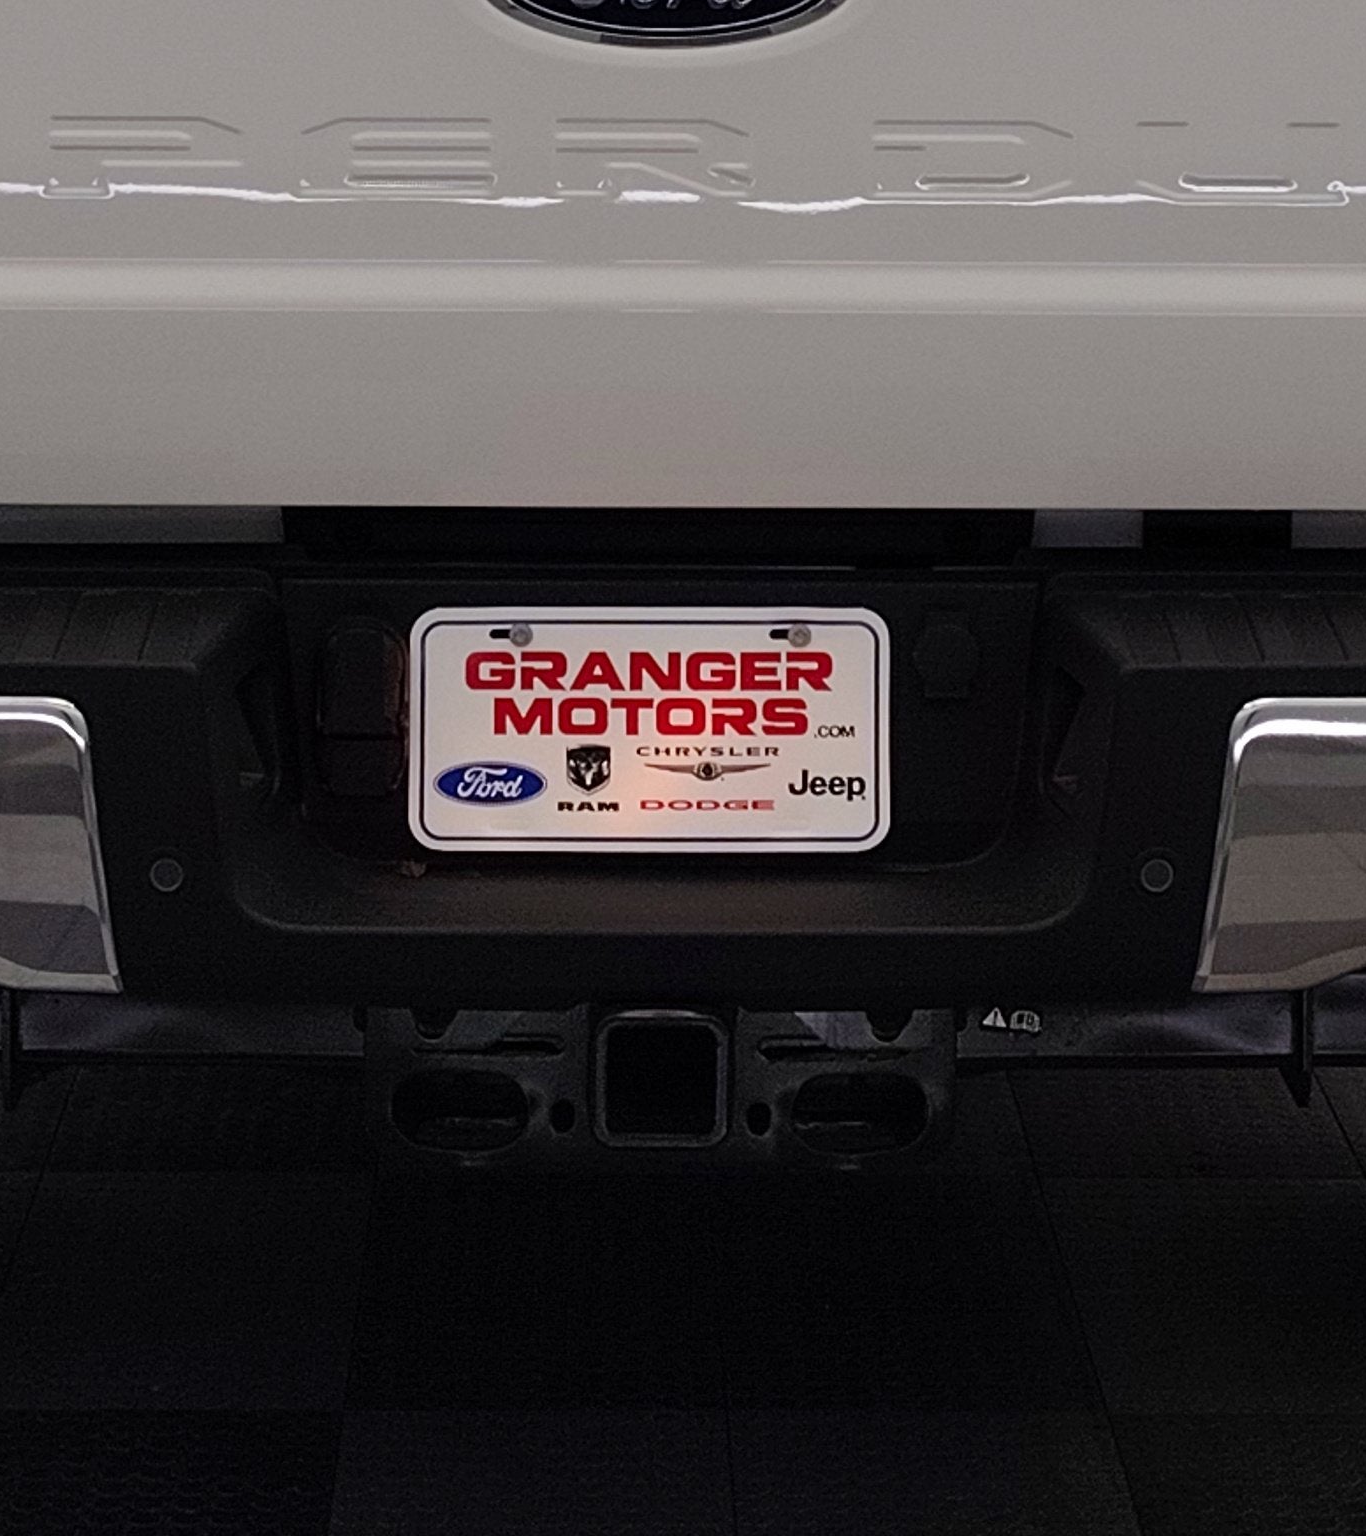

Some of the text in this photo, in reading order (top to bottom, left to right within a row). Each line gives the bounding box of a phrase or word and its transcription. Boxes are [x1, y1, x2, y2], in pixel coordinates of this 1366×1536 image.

[464, 651, 834, 692] GRANGER
[493, 698, 809, 736] MOTORS
[635, 746, 781, 758] CHRYSLER
[455, 767, 523, 799] Ford
[787, 770, 867, 802] Jeep
[556, 800, 620, 813] RAM
[639, 799, 776, 812] DODGE
